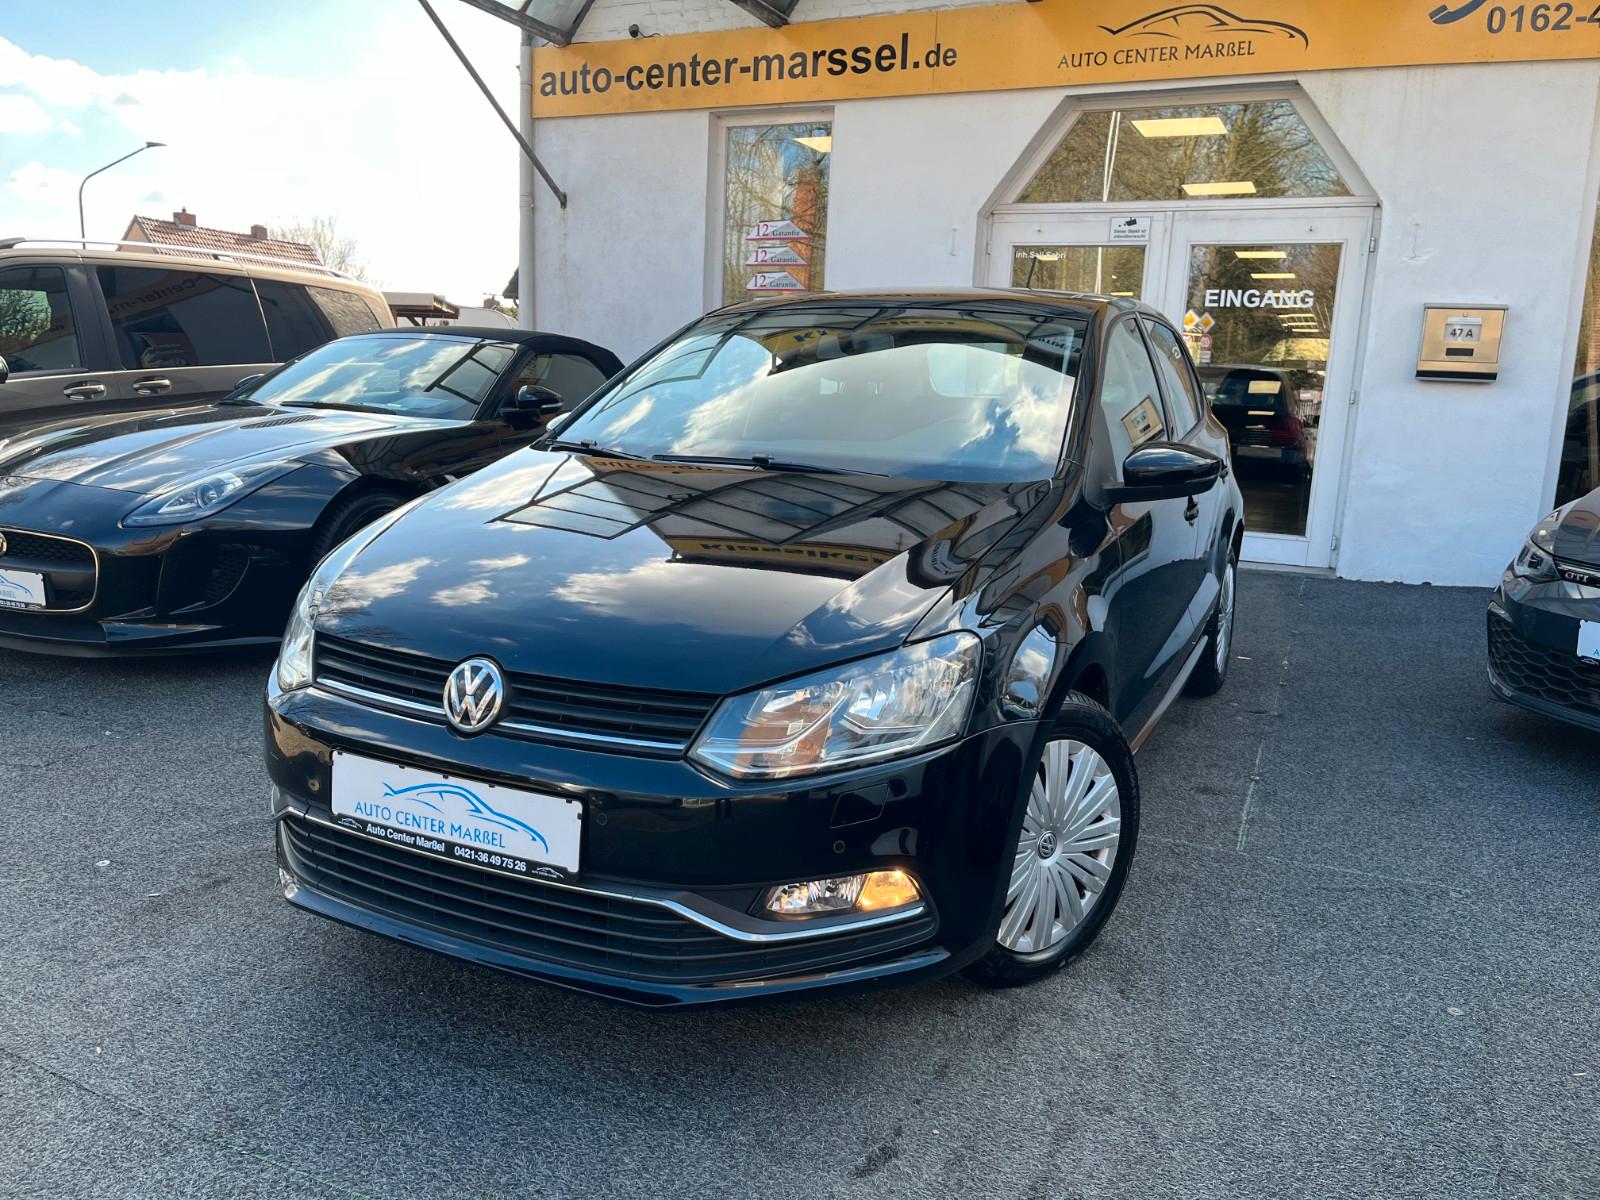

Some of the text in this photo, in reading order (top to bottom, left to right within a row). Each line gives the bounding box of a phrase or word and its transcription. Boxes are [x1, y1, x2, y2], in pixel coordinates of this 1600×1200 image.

[539, 32, 958, 97] auto-center-marssel.de
[1057, 51, 1108, 69] AUTO
[1113, 45, 1178, 65] CENTER
[754, 224, 769, 237] 12
[753, 250, 768, 263] 12
[752, 275, 767, 288] 12
[1204, 289, 1314, 308] EINGANG
[1564, 571, 1589, 583] GTI
[355, 801, 391, 822] AUTO
[395, 810, 445, 835] CENTER
[366, 823, 385, 837] Auto
[387, 829, 415, 845] Center
[454, 845, 489, 863] 0421-36
[490, 854, 501, 866] 49
[502, 857, 514, 869] 75
[514, 860, 527, 872] 26
